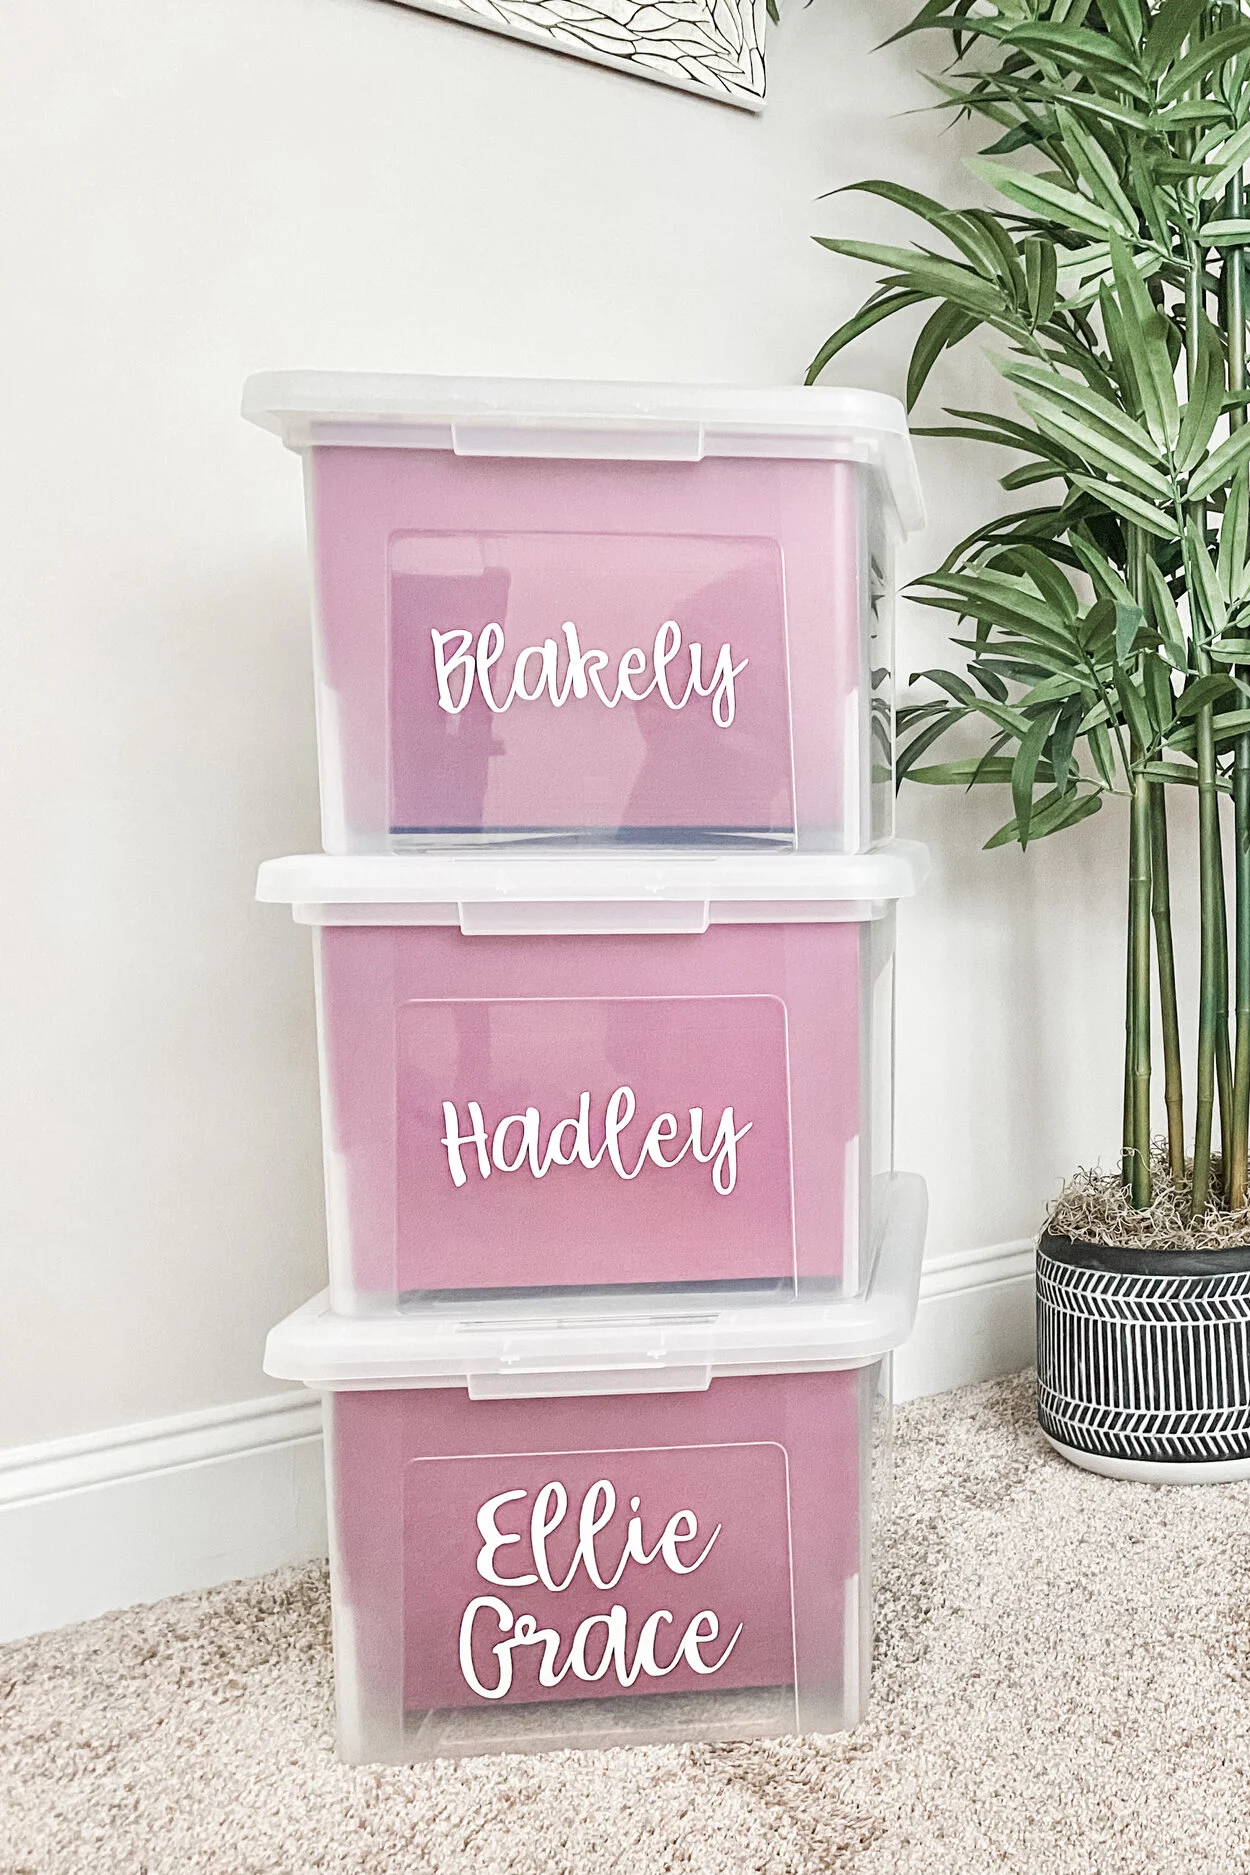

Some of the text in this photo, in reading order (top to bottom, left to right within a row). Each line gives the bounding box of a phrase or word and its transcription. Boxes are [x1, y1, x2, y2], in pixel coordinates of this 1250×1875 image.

[430, 620, 750, 729] Blakely
[440, 1085, 754, 1196] Hadley
[475, 1479, 722, 1592] Ellie
[458, 1595, 744, 1699] Grace
